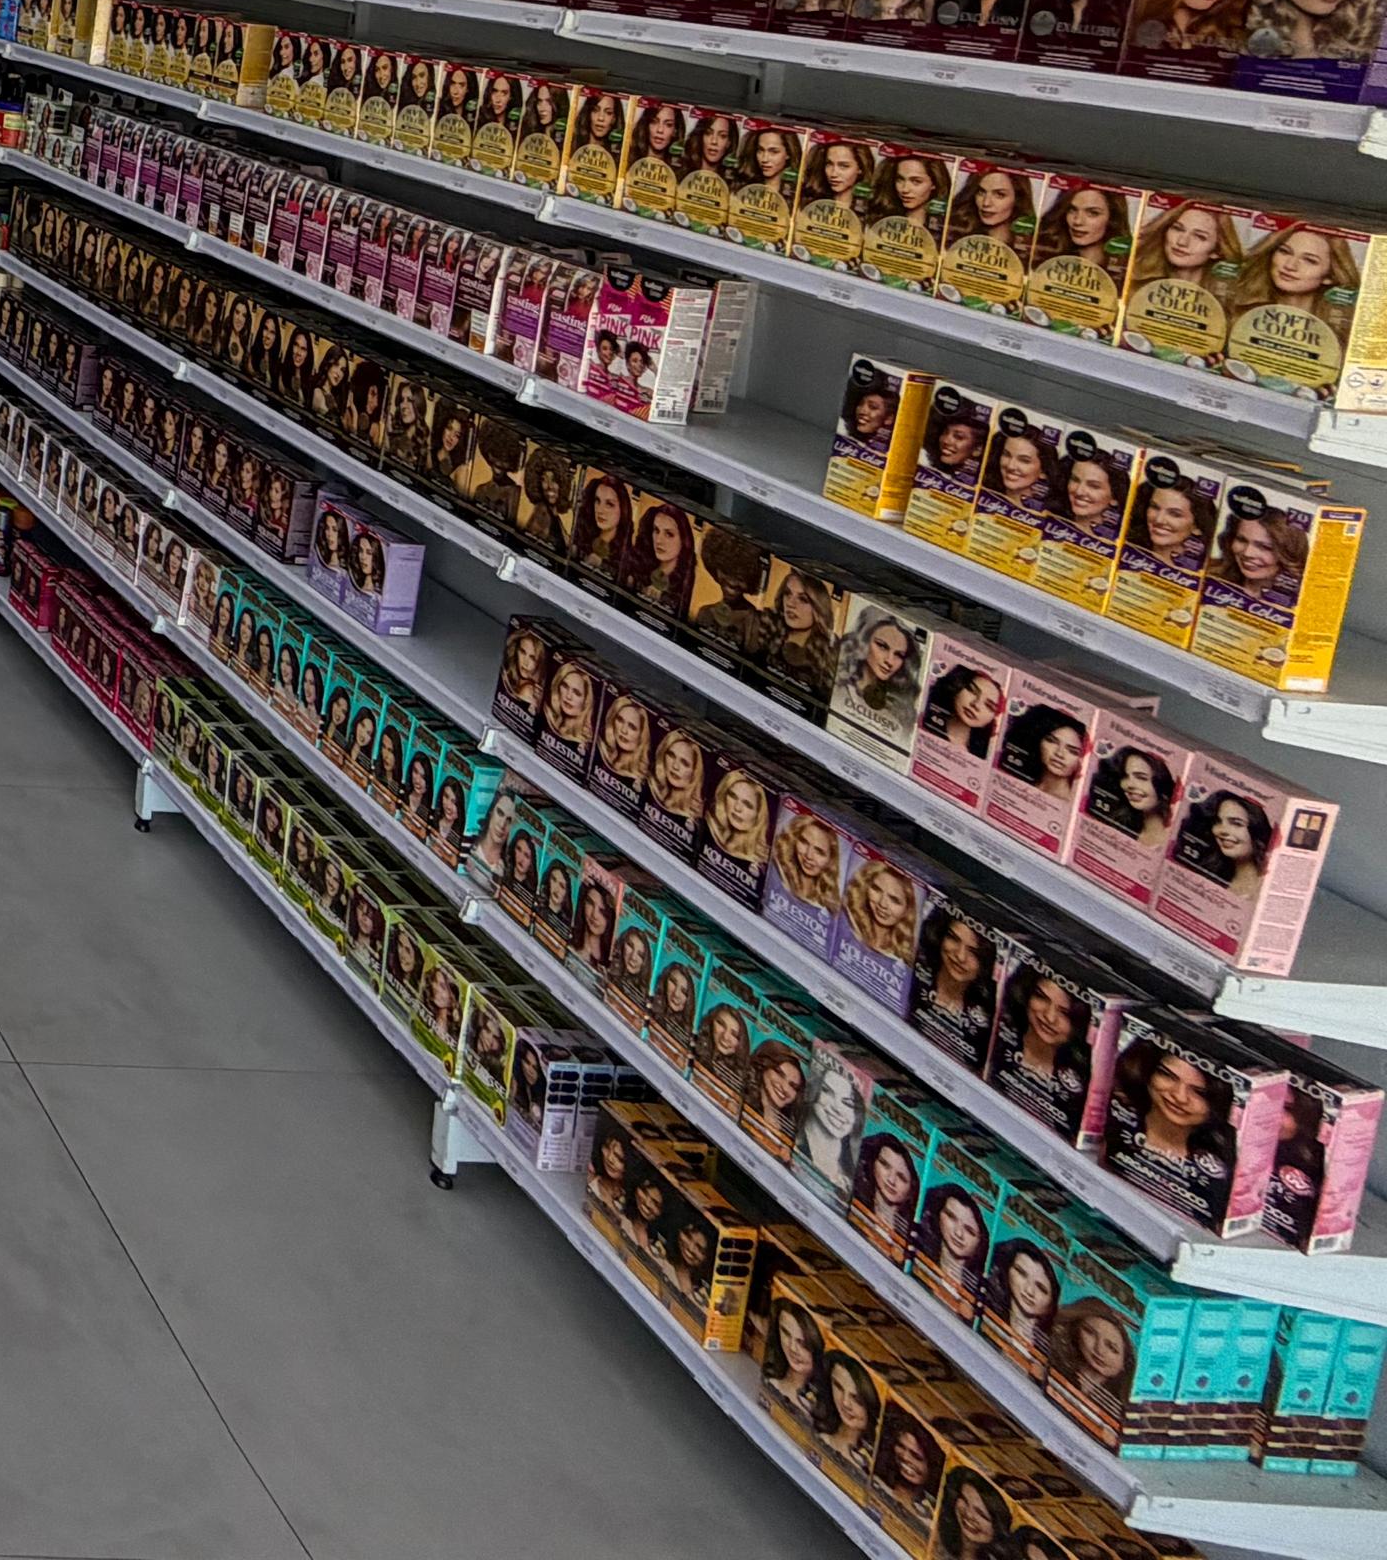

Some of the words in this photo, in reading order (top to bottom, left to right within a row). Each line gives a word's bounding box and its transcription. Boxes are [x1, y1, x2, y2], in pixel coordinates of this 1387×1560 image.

[1046, 268, 1102, 292] COLOR
[1054, 259, 1100, 280] SOFT
[1147, 292, 1210, 318] COLOR
[1157, 282, 1207, 304] SOFT
[599, 314, 628, 337] PINK
[631, 326, 661, 350] PINK
[1252, 318, 1323, 347] COLOR
[1263, 307, 1318, 332] SOFT
[1044, 521, 1078, 543] Light
[1080, 536, 1114, 555] Color
[1122, 550, 1157, 573] Light
[1159, 567, 1197, 588] Color
[1204, 585, 1245, 608] Light
[1248, 603, 1291, 625] Color
[594, 765, 641, 805] KOLESTON
[645, 802, 694, 844] KOLESTON
[702, 844, 758, 889] KOLESTON
[769, 889, 830, 938] KOLESTON
[929, 893, 1006, 950] BEAUTYCOLOR
[839, 938, 904, 993] KOLESTON
[1014, 948, 1101, 1010] BEAUTYCOLOR
[1126, 1020, 1247, 1090] BEAUTYCOLOR
